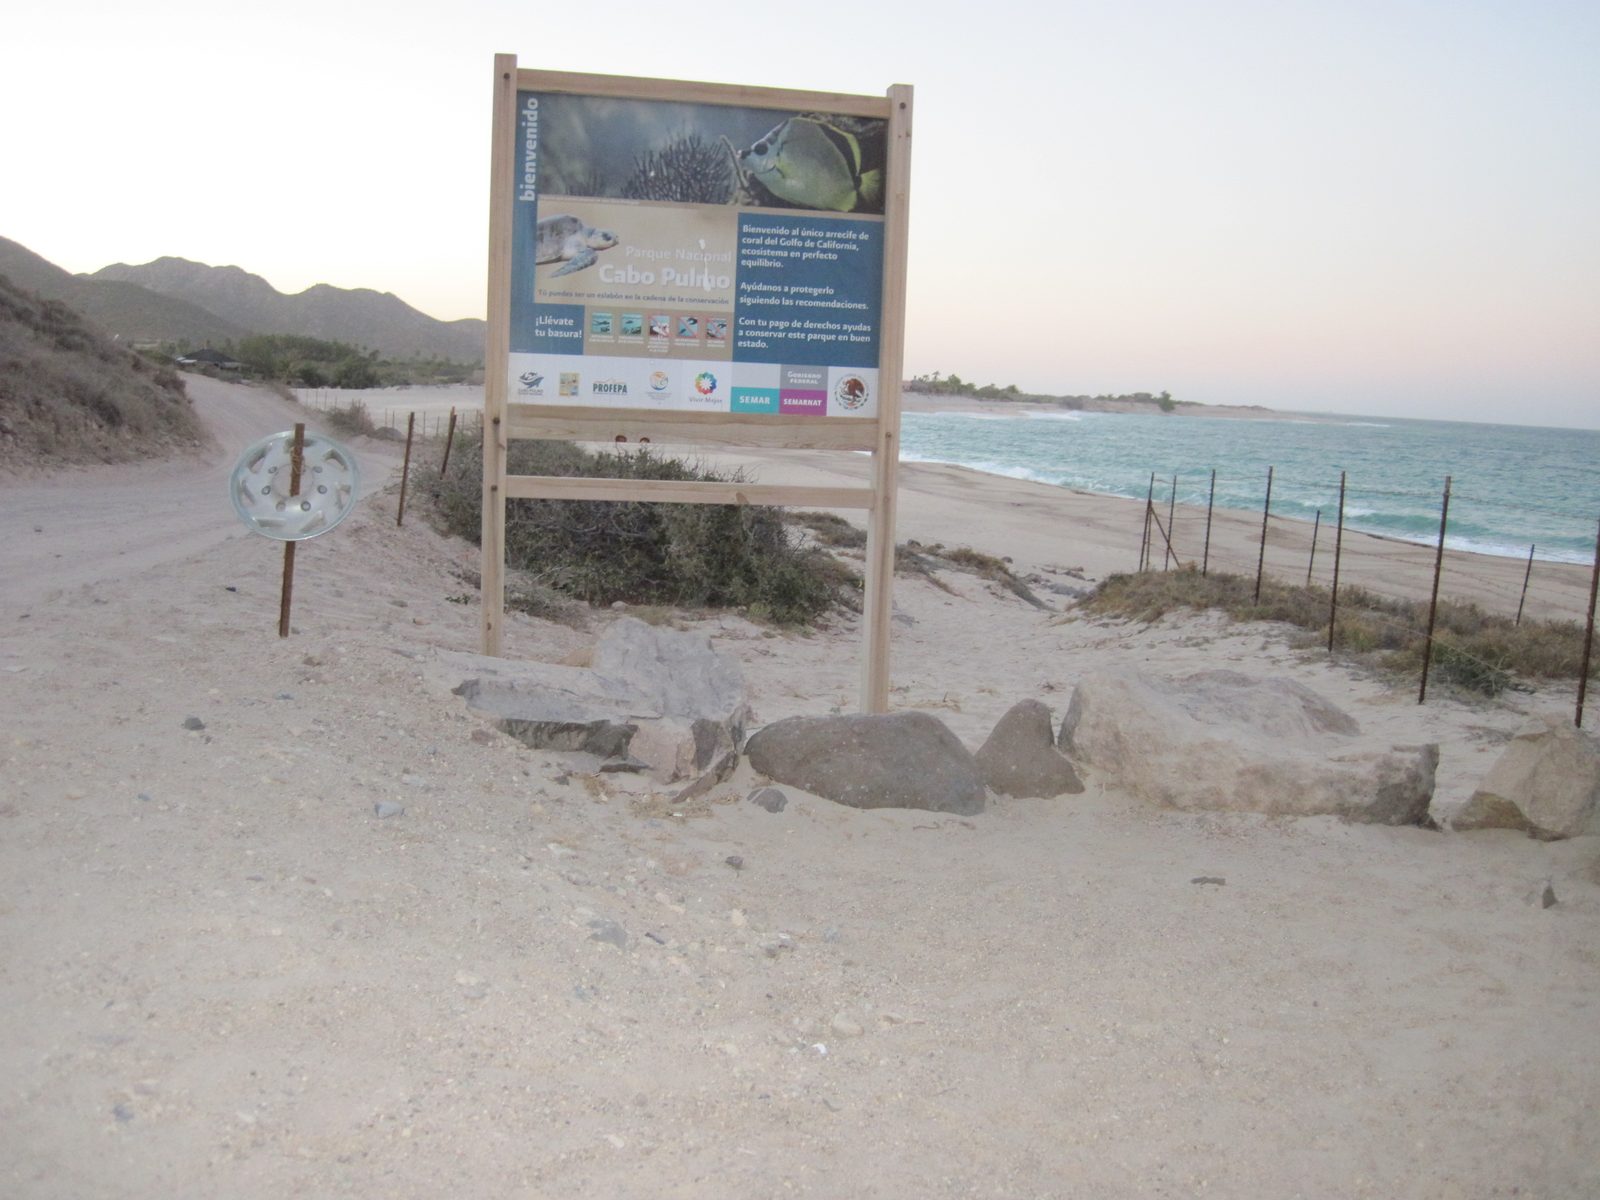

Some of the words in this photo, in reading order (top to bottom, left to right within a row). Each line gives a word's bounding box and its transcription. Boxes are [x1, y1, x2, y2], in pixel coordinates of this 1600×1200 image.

[520, 98, 538, 202] bienvenido
[743, 225, 789, 235] Bienvenido
[801, 228, 824, 237] único
[826, 230, 857, 239] arrecife
[780, 238, 802, 247] Golfo
[817, 241, 859, 251] California,
[625, 247, 672, 261] Parque
[676, 249, 732, 262] Nacional
[742, 249, 788, 257] ecosistema
[802, 251, 837, 260] perfecto
[741, 259, 784, 268] equilibrio.
[598, 264, 655, 285] Cabo
[661, 267, 731, 289] Pulmo
[740, 282, 782, 293] Ayúdanos
[791, 285, 834, 296] protegerlo
[596, 291, 623, 300] eslabón
[685, 296, 729, 305] conservación
[739, 296, 780, 306] siguiendo
[795, 300, 868, 310] recomendaciones.
[535, 316, 574, 326] ¡Llévate
[739, 317, 755, 326] Con
[804, 321, 840, 330] derechos
[843, 322, 871, 332] ayudas
[535, 328, 546, 337] tu
[548, 328, 582, 338] basura!
[745, 330, 785, 338] conservar
[808, 334, 836, 343] parque
[850, 334, 870, 342] buen
[738, 340, 768, 348] estado.
[592, 382, 628, 393] PROFEPA
[739, 395, 770, 405] SEMAR
